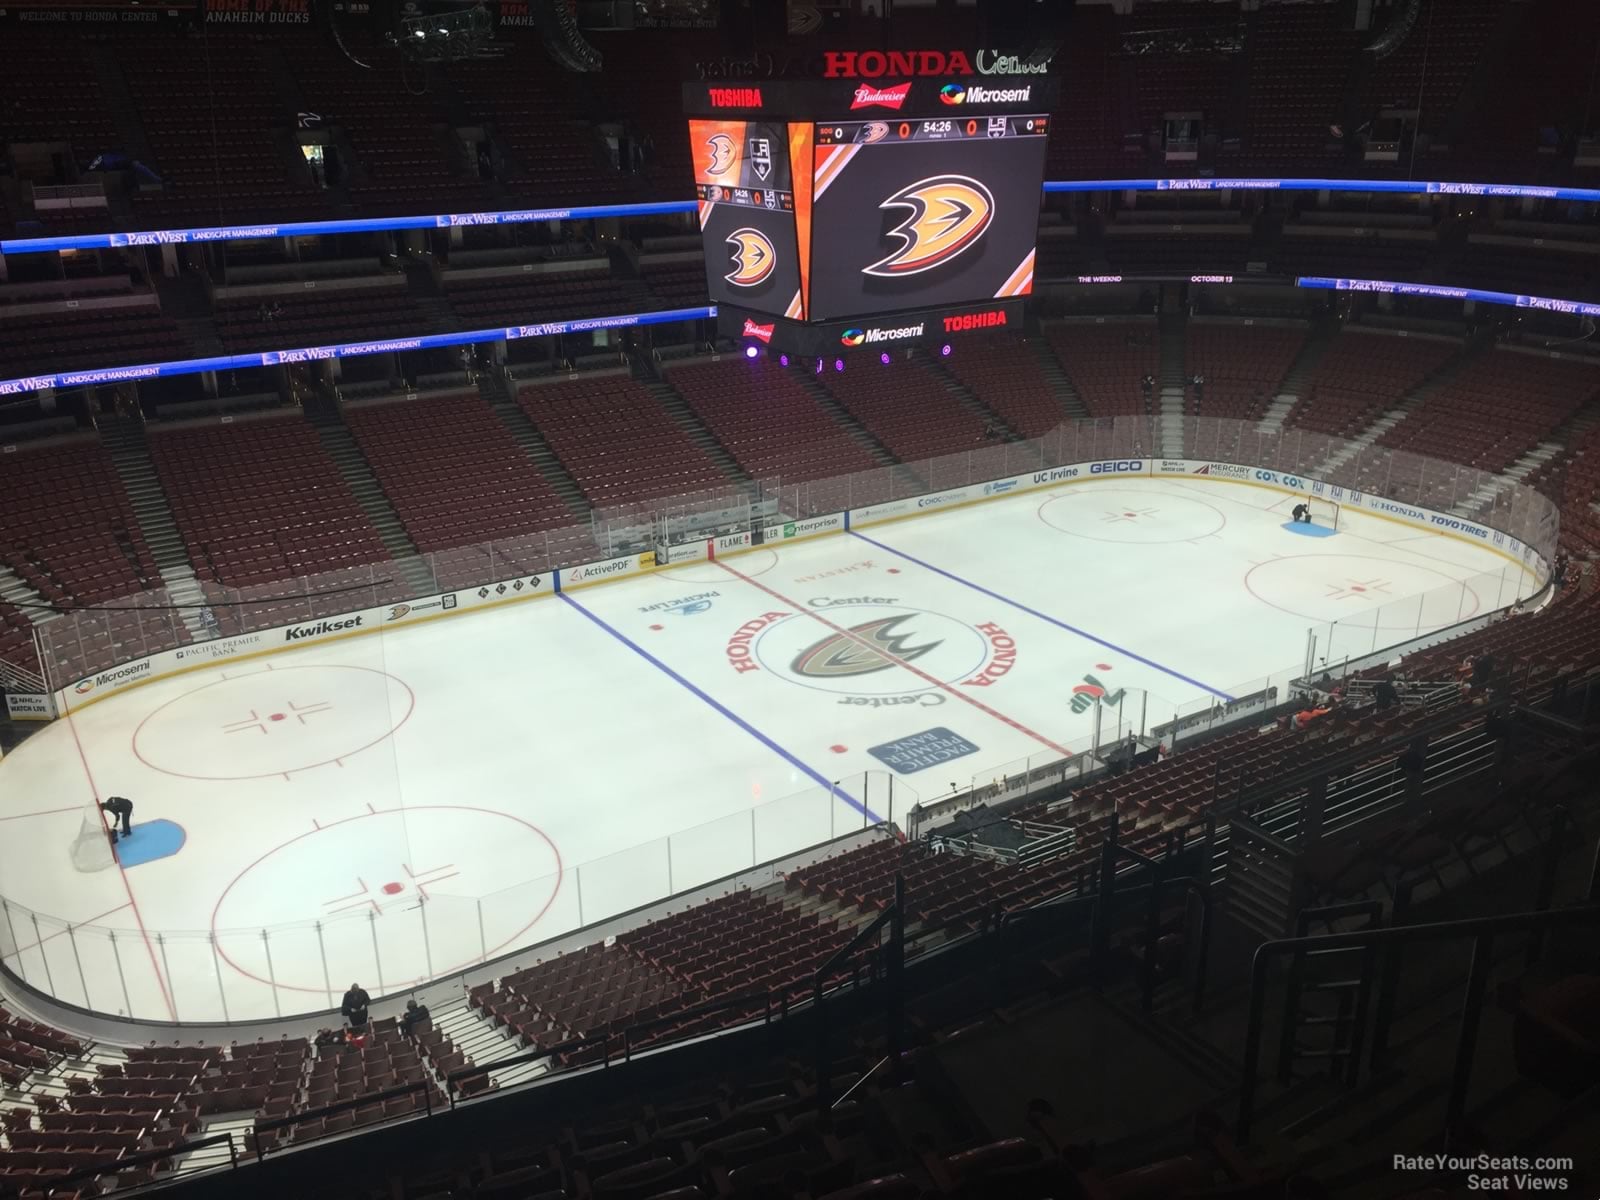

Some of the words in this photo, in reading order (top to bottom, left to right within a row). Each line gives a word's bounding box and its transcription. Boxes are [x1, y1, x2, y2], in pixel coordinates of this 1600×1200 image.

[86, 12, 118, 22] HONDA
[121, 12, 158, 22] CENTER
[206, 11, 265, 23] ANAHEIM
[269, 12, 310, 23] DUCKS
[824, 50, 974, 78] HONDA
[709, 88, 763, 107] TOSHIBA
[854, 88, 907, 103] Budweiser
[966, 85, 1032, 104] Microsemi
[834, 127, 843, 139] 0
[898, 122, 911, 140] 0
[923, 120, 952, 133] 54:26
[966, 119, 978, 137] 0
[1026, 119, 1034, 131] 0
[1169, 179, 1190, 190] PARK
[1189, 179, 1212, 190] WEST
[1439, 182, 1461, 193] PARK
[1460, 183, 1485, 195] WEST
[723, 188, 731, 202] 0
[753, 190, 761, 206] 0
[450, 213, 475, 226] PARK
[473, 212, 498, 225] WEST
[128, 232, 157, 246] PARK
[155, 230, 188, 244] WEST
[192, 229, 231, 241] LANDSCAPE
[232, 227, 279, 238] MANAGEMENT
[1078, 275, 1092, 283] THE
[1191, 275, 1225, 283] OCTOBER
[1530, 296, 1551, 310] PARK
[1550, 299, 1578, 313] WEST
[943, 310, 1007, 332] TOSHIBA
[519, 325, 543, 337] PARK
[541, 323, 567, 336] WEST
[865, 322, 924, 344] Microsemi
[279, 350, 306, 363] PARK
[304, 347, 336, 360] WEST
[340, 345, 378, 356] LANDSCAPE
[377, 339, 421, 351] MANAGEMENT
[0, 382, 23, 395] ARK
[19, 376, 57, 391] WEST
[62, 371, 108, 385] LANDSCAPE
[106, 366, 160, 380] MANAGEMENT
[1033, 472, 1048, 484] UC
[1050, 467, 1079, 481] Irvine
[1090, 461, 1143, 474] GEICO
[1210, 463, 1251, 474] MERCURY
[1255, 470, 1279, 484] COX
[1282, 475, 1305, 490] COX
[1380, 503, 1425, 520] HONDA
[1460, 523, 1489, 539] TIRES
[720, 535, 743, 549] FLAME
[584, 560, 629, 578] ActivePDF
[668, 590, 721, 608] PACIFIC
[807, 595, 899, 608] Center
[285, 615, 363, 642] Kwikset
[185, 644, 220, 658] PACIFIC
[222, 634, 261, 650] PREMIER
[726, 611, 793, 674] HONDA
[212, 647, 238, 658] BANK
[959, 621, 1017, 687] HONDA
[96, 659, 151, 688] Microsemi
[837, 692, 947, 708] Center
[10, 705, 33, 713] WATCH
[33, 705, 47, 713] LIVE
[884, 735, 963, 764] PREMIER
[886, 732, 938, 753] BANK
[900, 743, 970, 771] PACIFIC
